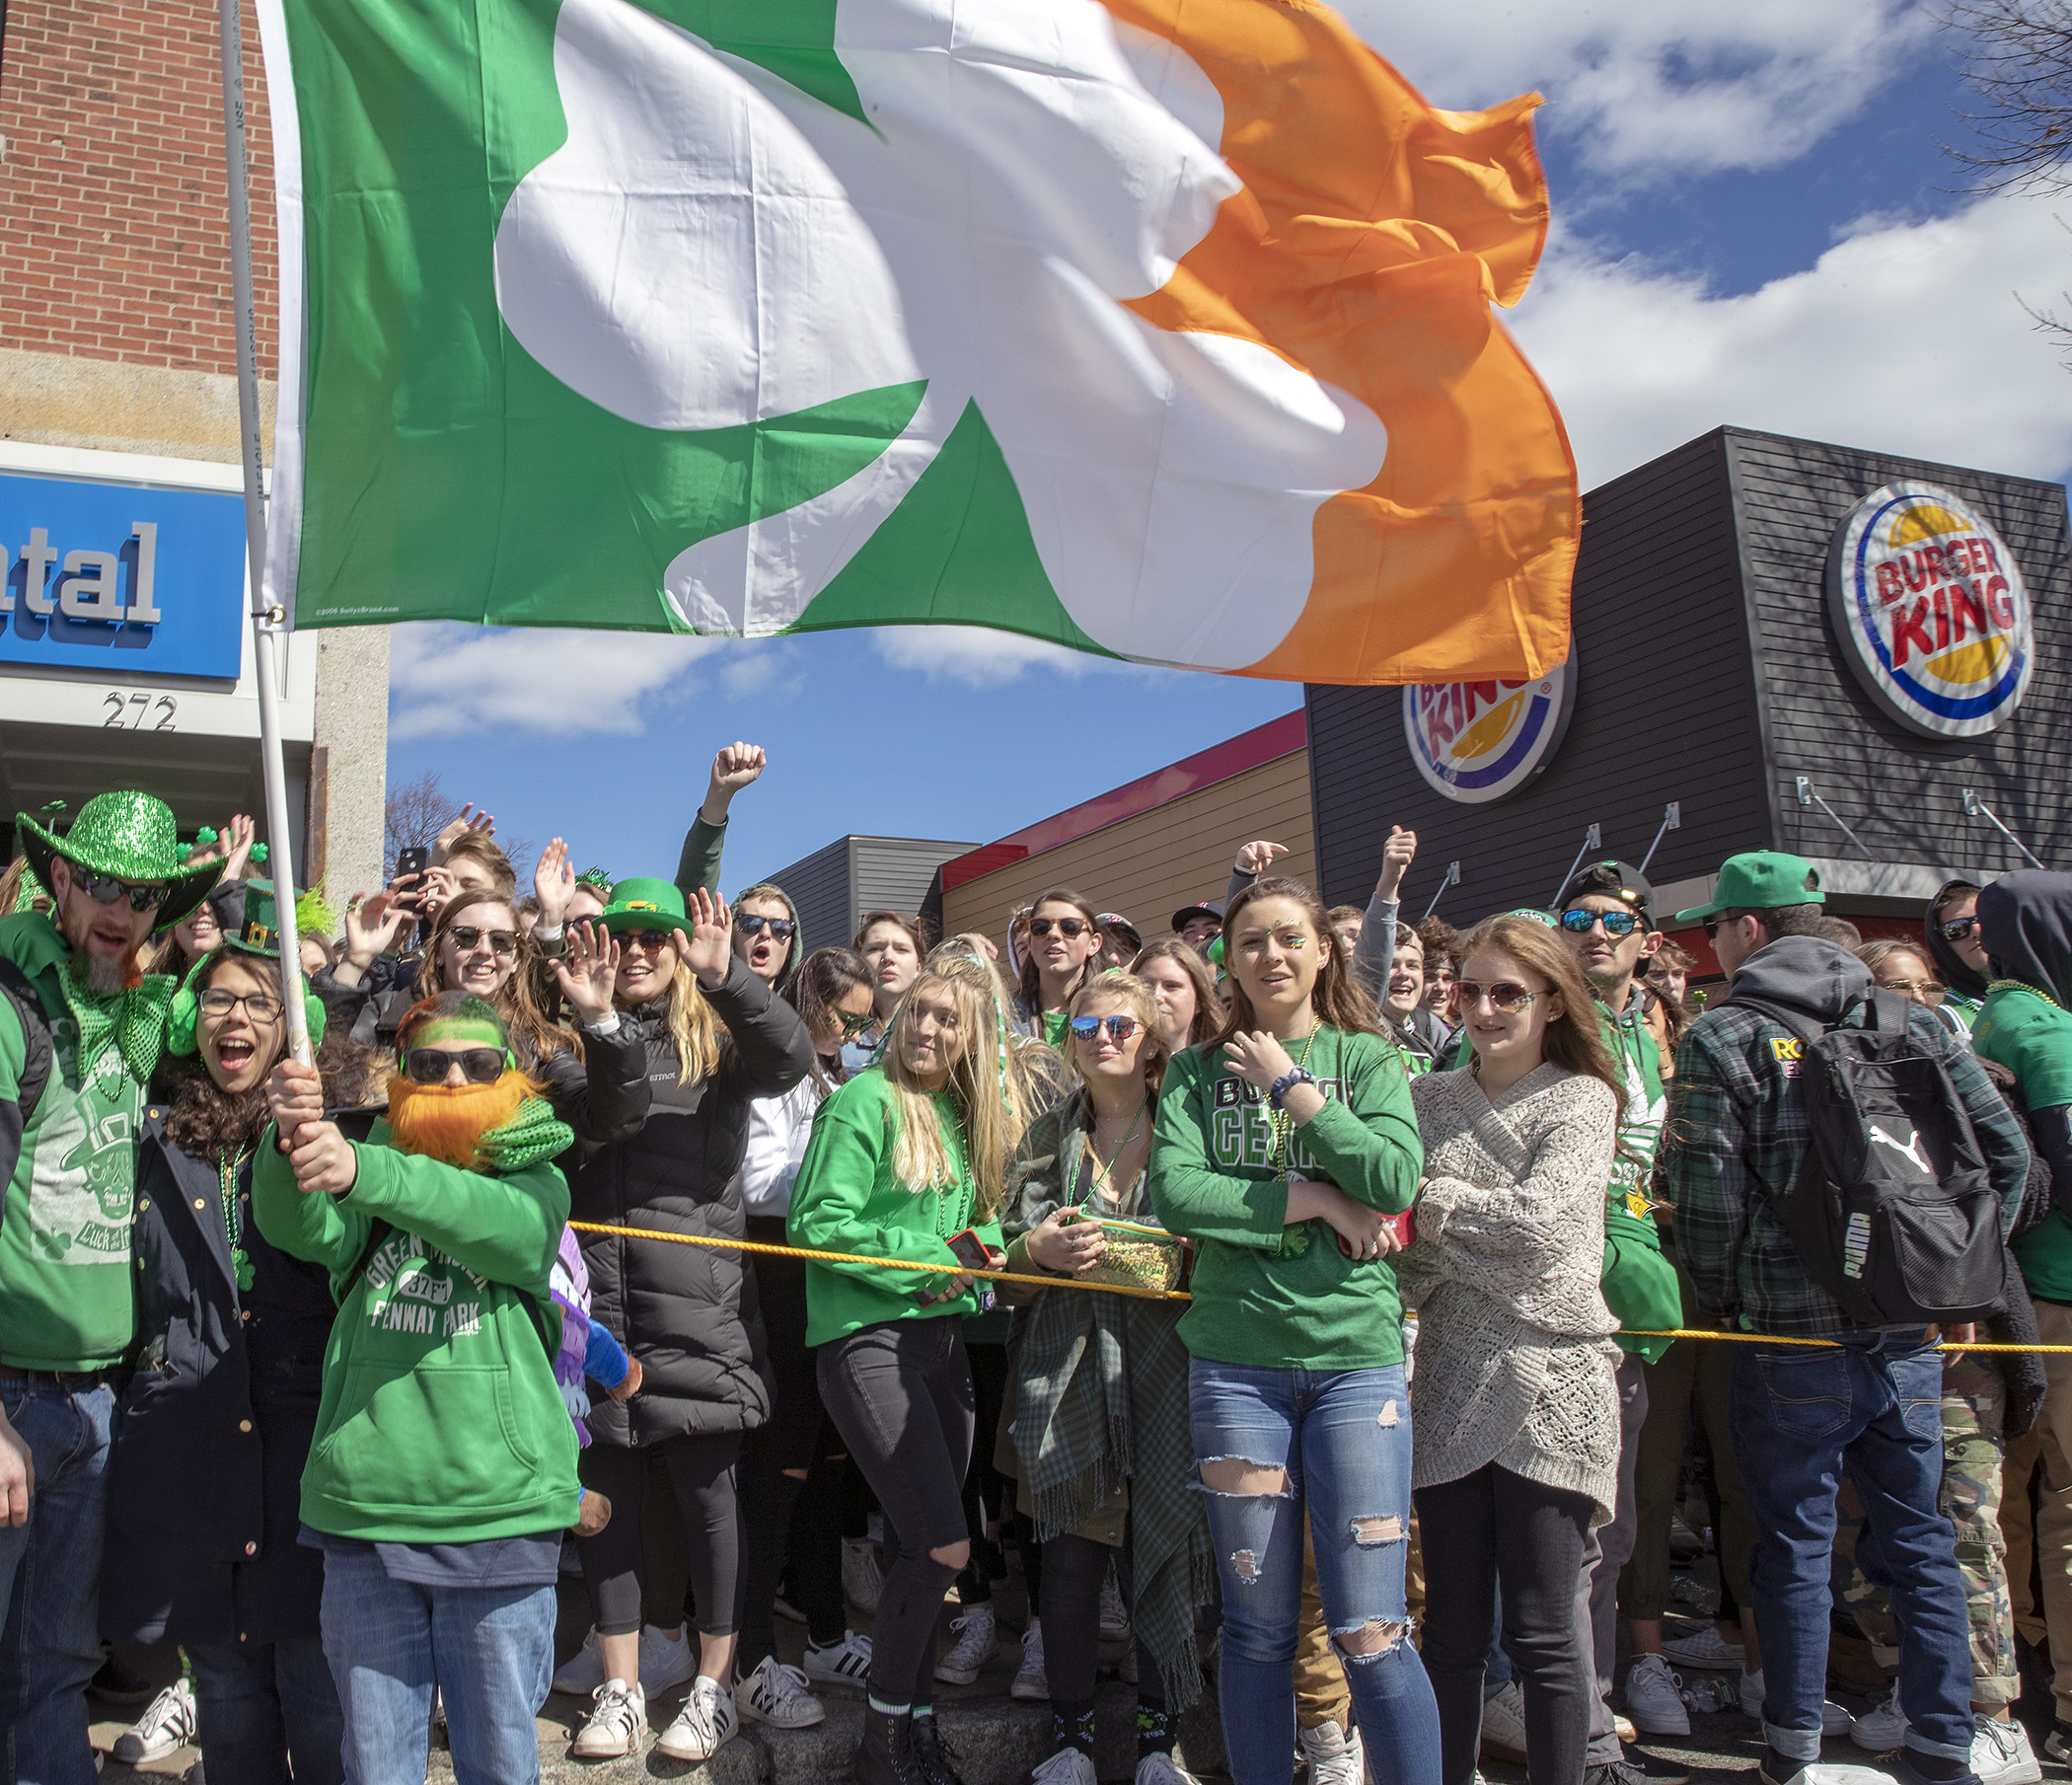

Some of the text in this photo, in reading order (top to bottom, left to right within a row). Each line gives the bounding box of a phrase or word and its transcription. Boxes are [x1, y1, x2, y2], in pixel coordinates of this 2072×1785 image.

[0, 521, 161, 624] tal
[1875, 538, 2002, 607] BURGER
[1890, 574, 2014, 668] KING
[103, 692, 178, 731] 272
[1428, 680, 1529, 761] KIN
[648, 1072, 676, 1081] armot
[366, 1232, 423, 1290] GREEN
[1843, 1212, 1871, 1279] PUMA
[371, 1300, 436, 1335] FENWAY
